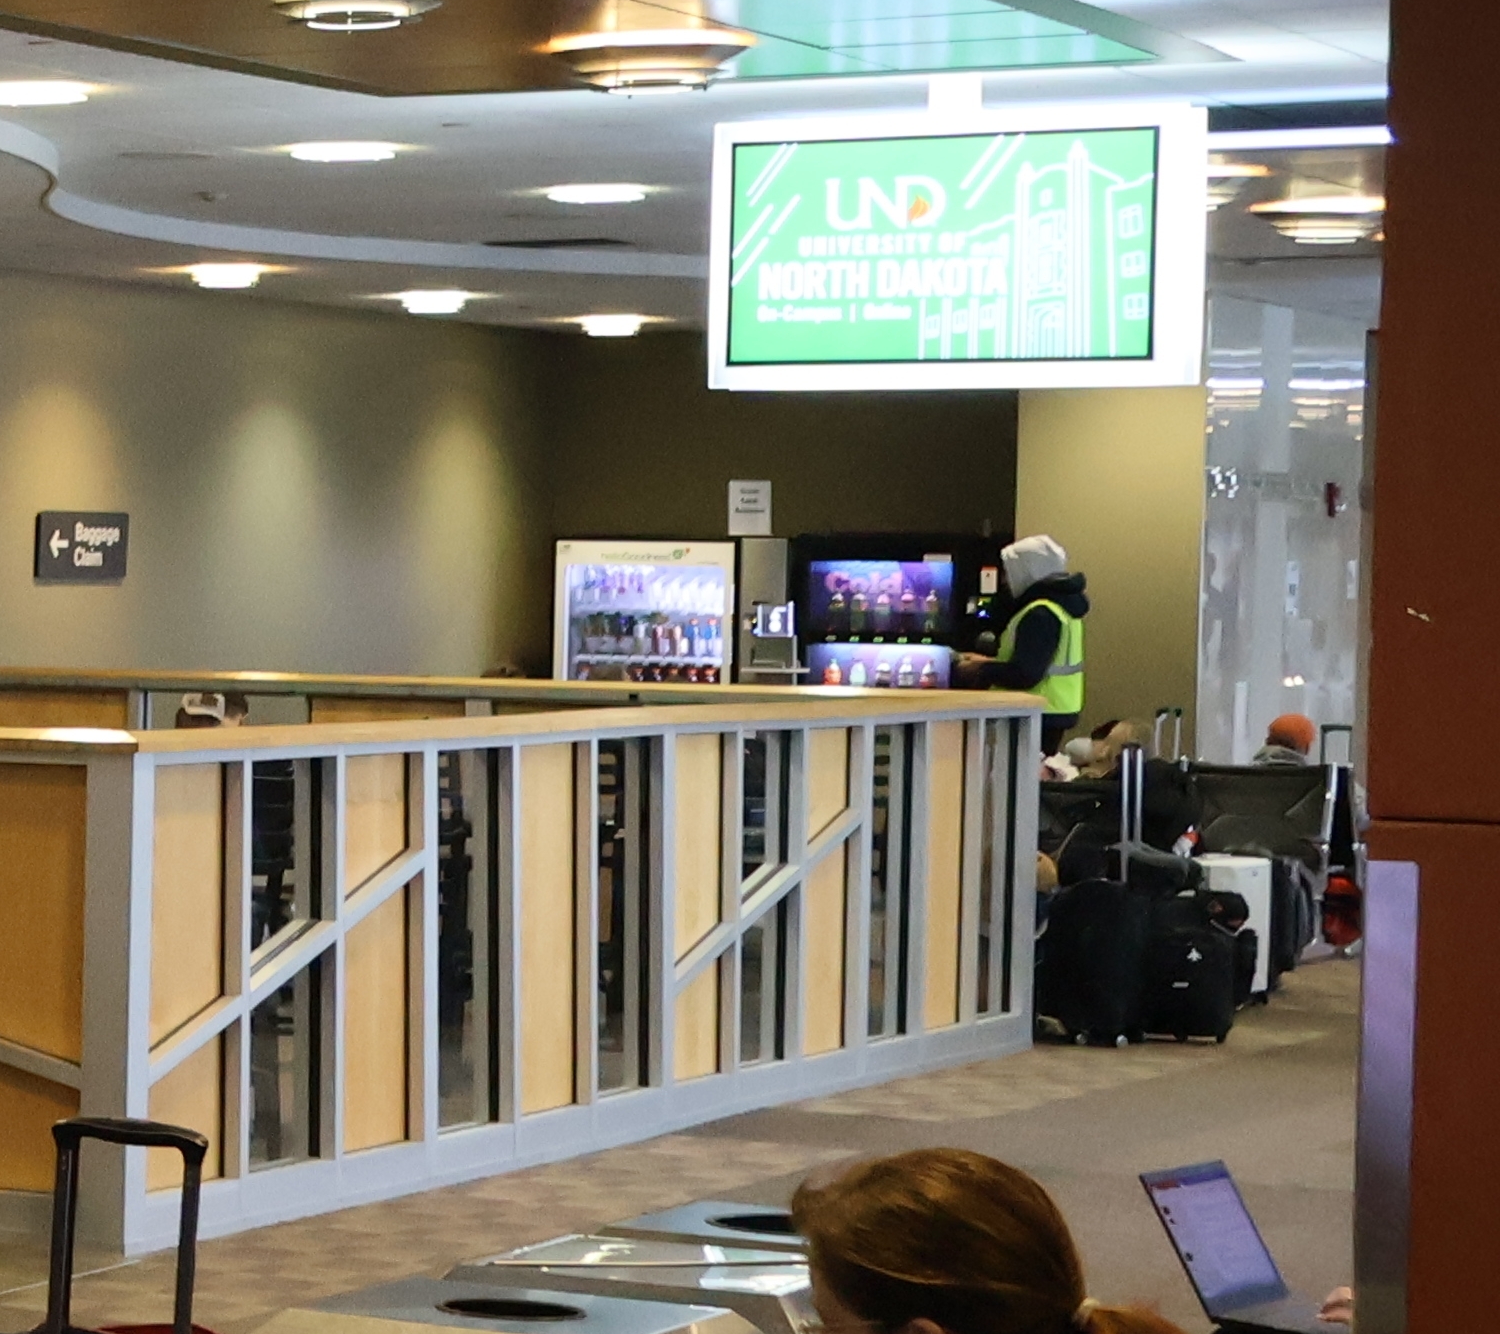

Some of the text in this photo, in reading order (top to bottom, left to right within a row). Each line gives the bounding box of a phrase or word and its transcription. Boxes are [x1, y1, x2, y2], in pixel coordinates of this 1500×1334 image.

[824, 174, 947, 231] UND
[798, 230, 967, 257] UNIVERSITY OF
[757, 255, 1008, 300] NORTH DAKOTA
[756, 302, 843, 324] On-Campus
[74, 521, 121, 547] Baggage
[73, 546, 104, 568] Claim
[824, 570, 904, 594] Cold
